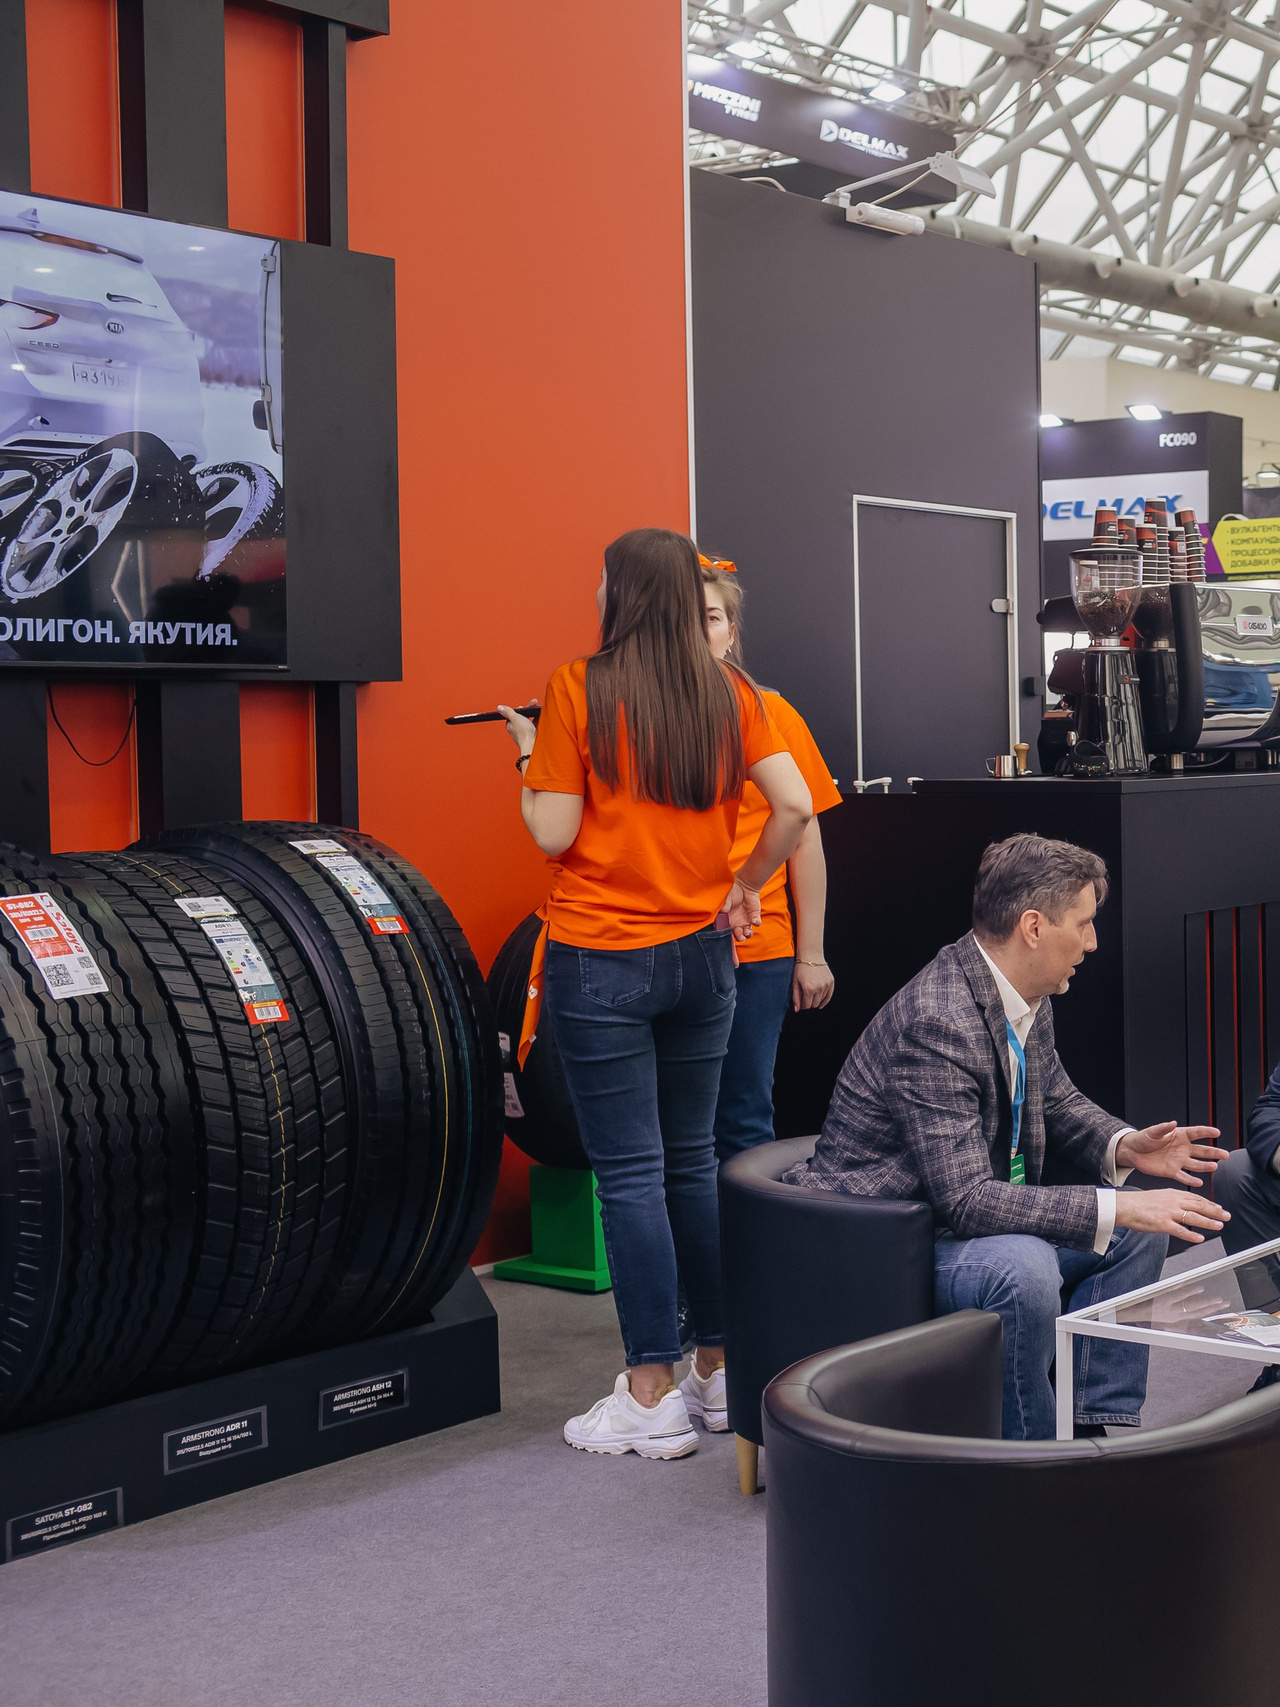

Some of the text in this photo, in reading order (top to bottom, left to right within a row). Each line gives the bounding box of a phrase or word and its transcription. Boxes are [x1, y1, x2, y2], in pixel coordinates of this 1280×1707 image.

[837, 127, 910, 160] DELMAX
[107, 322, 124, 334] KIA
[1159, 432, 1197, 447] FC090
[1043, 494, 1183, 520] ELMAX
[1230, 559, 1269, 568] ДОБАВКИ
[128, 621, 238, 645] ЯКУТИЯ.
[52, 912, 84, 953] Satoya
[333, 1386, 370, 1402] ARMSTRONG
[371, 1383, 384, 1392] ASH
[181, 1420, 248, 1444] ARMSTRONG ADR 11
[35, 1502, 93, 1525] SATOYA ST-082
